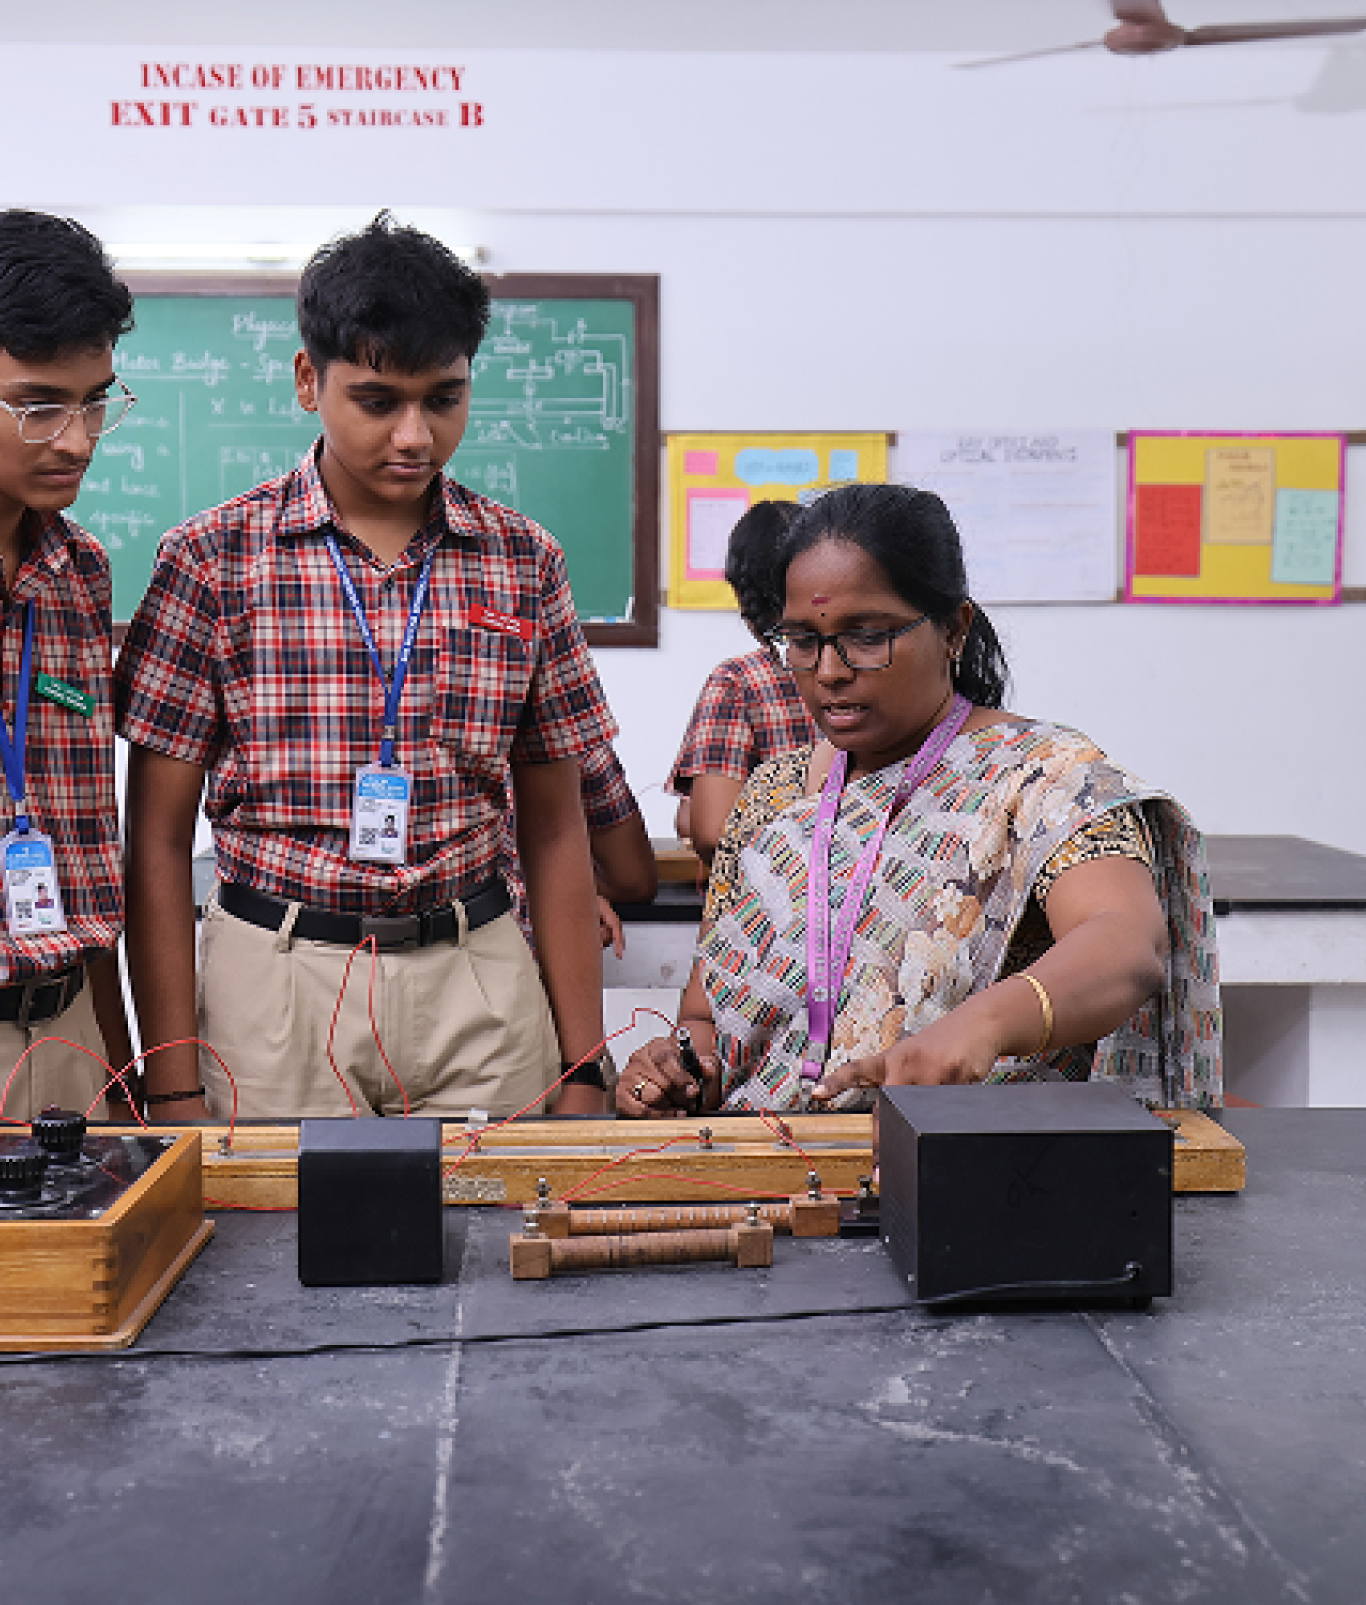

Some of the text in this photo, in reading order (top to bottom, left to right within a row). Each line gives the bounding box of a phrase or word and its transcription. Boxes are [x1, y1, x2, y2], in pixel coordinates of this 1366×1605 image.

[139, 63, 466, 91] INCASE OF EMERGENCY
[109, 100, 485, 129] EXIT GATE 5 STAIRCASE B
